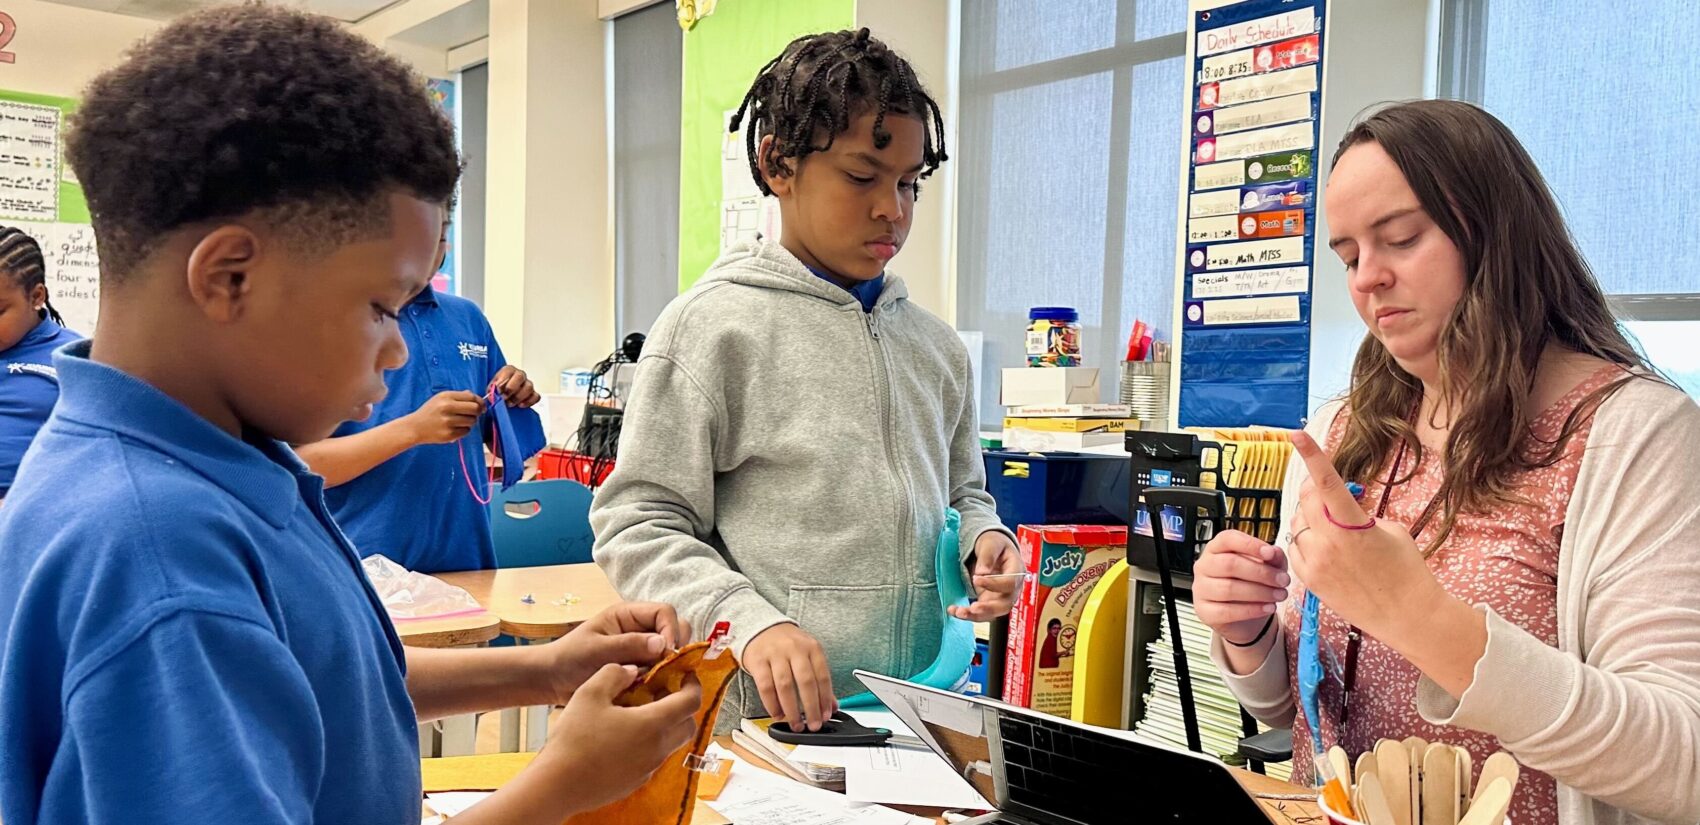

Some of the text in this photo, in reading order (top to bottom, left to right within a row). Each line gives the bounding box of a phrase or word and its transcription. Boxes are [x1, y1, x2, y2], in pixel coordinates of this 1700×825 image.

[1207, 28, 1238, 51] Daily
[1260, 220, 1281, 230] Math
[1235, 253, 1255, 266] Math
[57, 269, 80, 282] four
[1197, 274, 1229, 285] Specials
[1109, 421, 1124, 429] BAM
[1042, 551, 1082, 576] Judy
